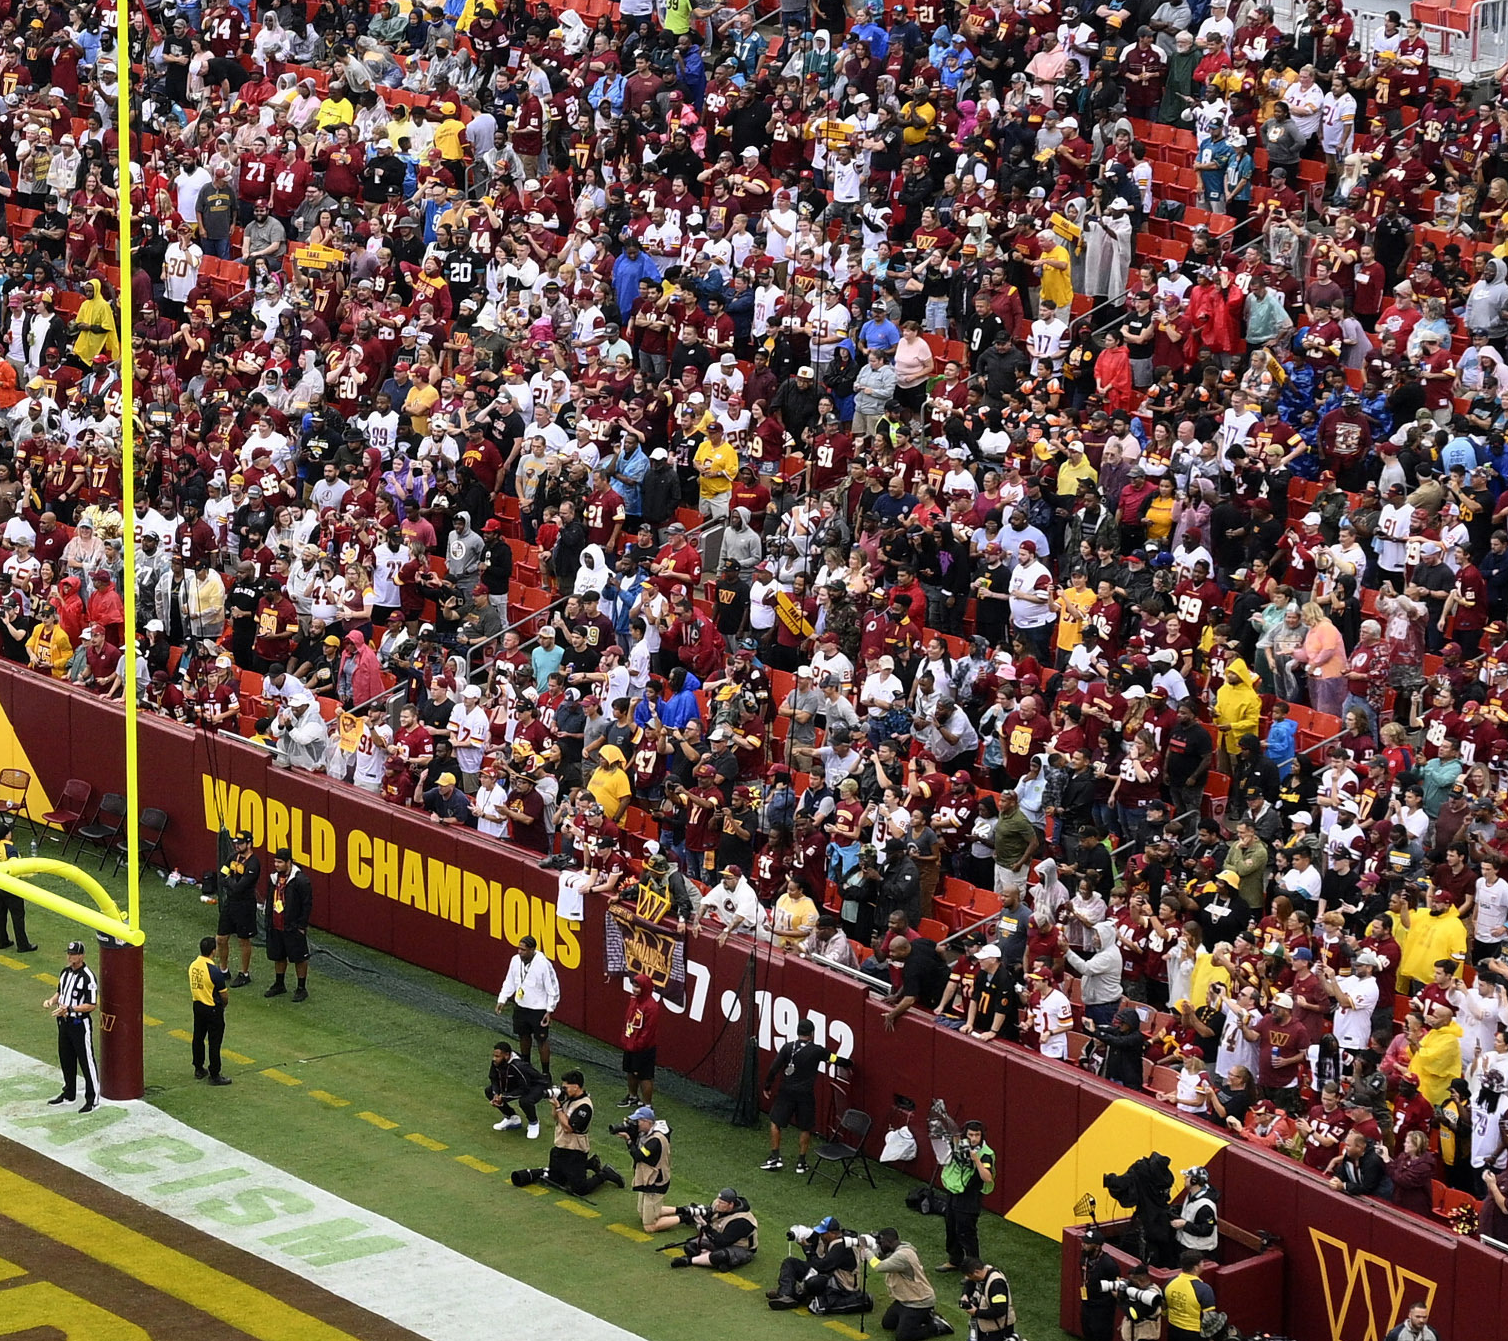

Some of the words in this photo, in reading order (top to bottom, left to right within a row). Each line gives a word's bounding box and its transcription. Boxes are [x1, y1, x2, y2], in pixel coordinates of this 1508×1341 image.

[246, 162, 265, 181] 71
[276, 173, 293, 191] 44
[451, 263, 471, 282] 20
[201, 774, 340, 876] WORLD
[345, 830, 582, 969] CHAMPIONS
